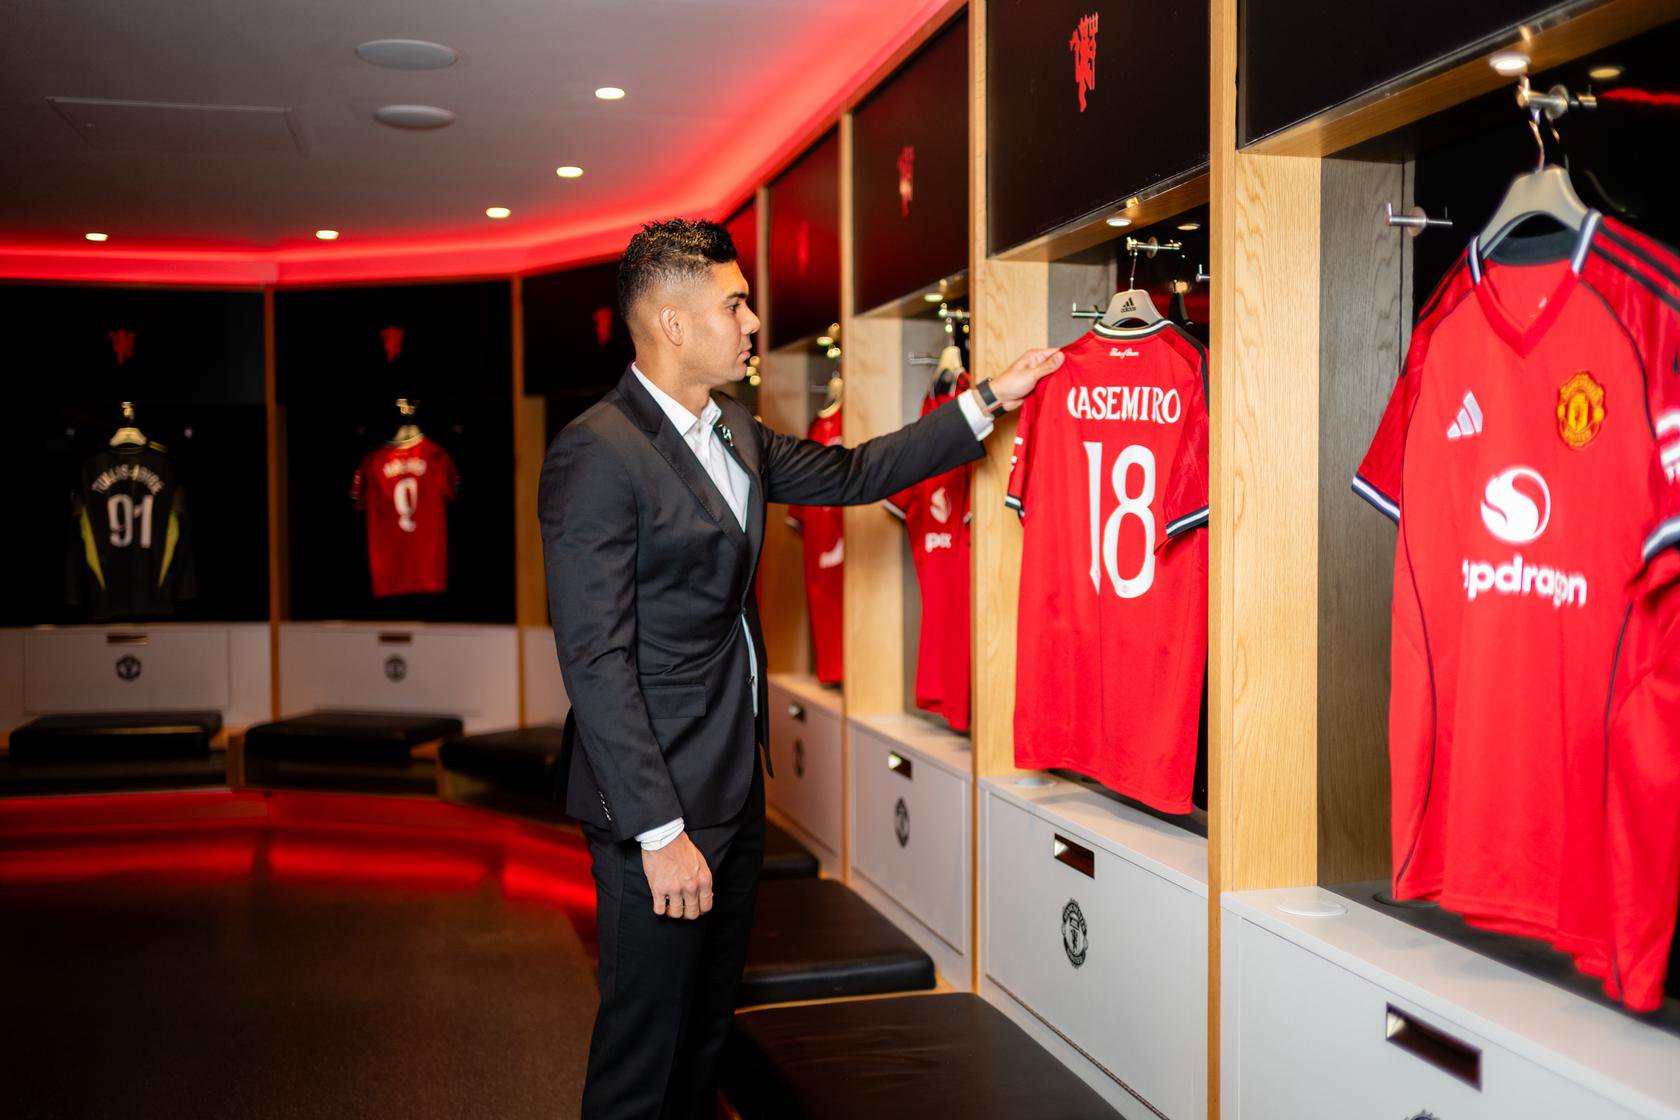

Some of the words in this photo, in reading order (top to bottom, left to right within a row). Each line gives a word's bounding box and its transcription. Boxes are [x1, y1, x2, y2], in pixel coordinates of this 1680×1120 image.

[1066, 386, 1181, 424] CASEMIRO
[107, 493, 154, 549] 91
[1083, 441, 1156, 599] 18
